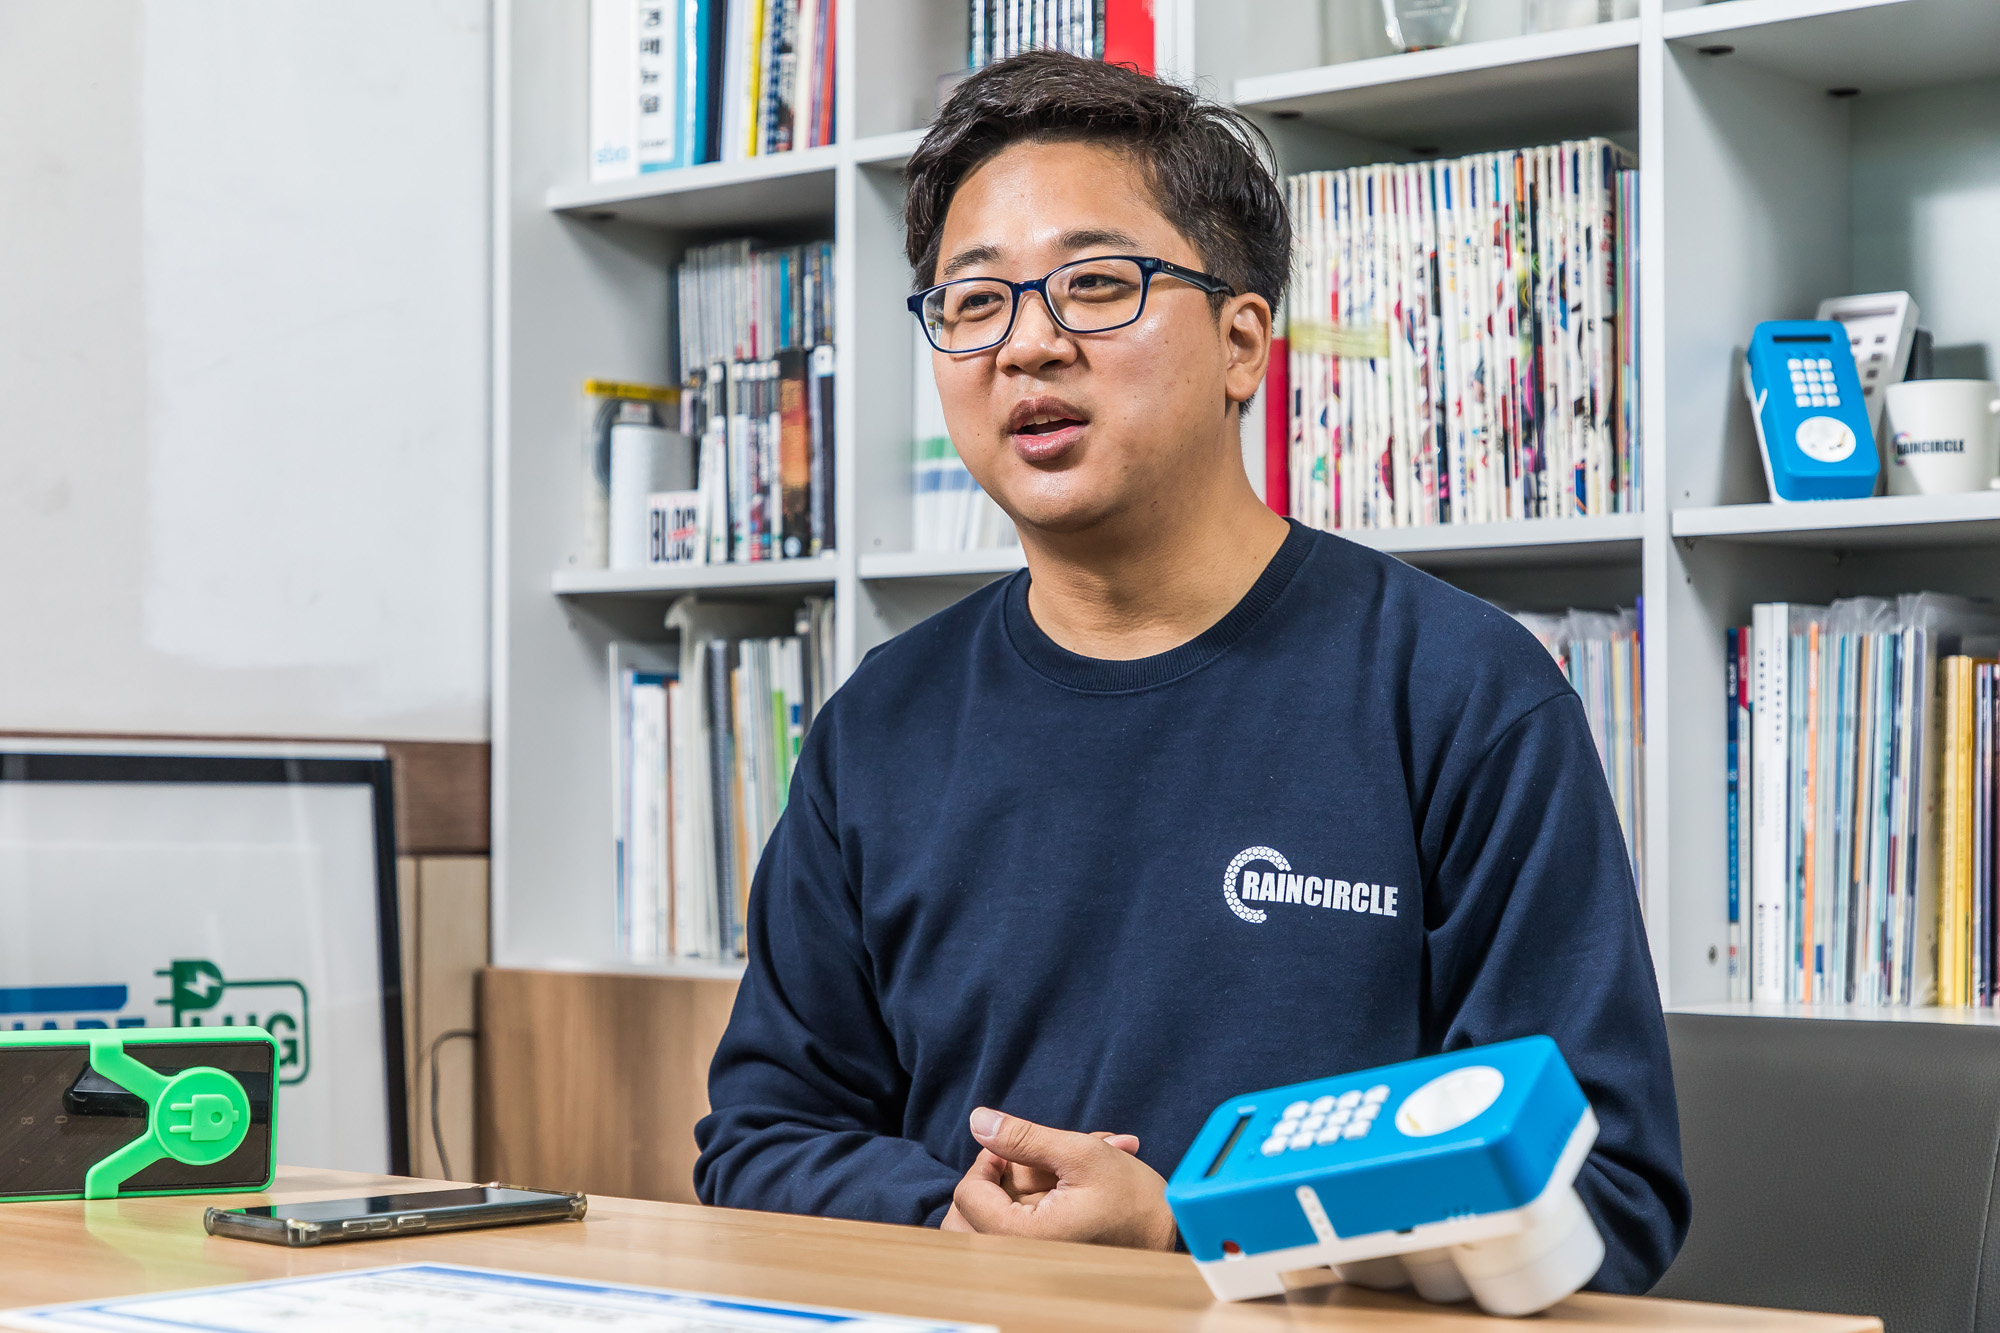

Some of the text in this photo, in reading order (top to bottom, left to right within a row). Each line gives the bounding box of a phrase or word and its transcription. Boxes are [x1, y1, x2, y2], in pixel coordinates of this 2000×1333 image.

[1897, 439, 1965, 455] RAINCIRCLE
[1241, 870, 1399, 917] RAINCIRCLE
[20, 1116, 34, 1125] 8
